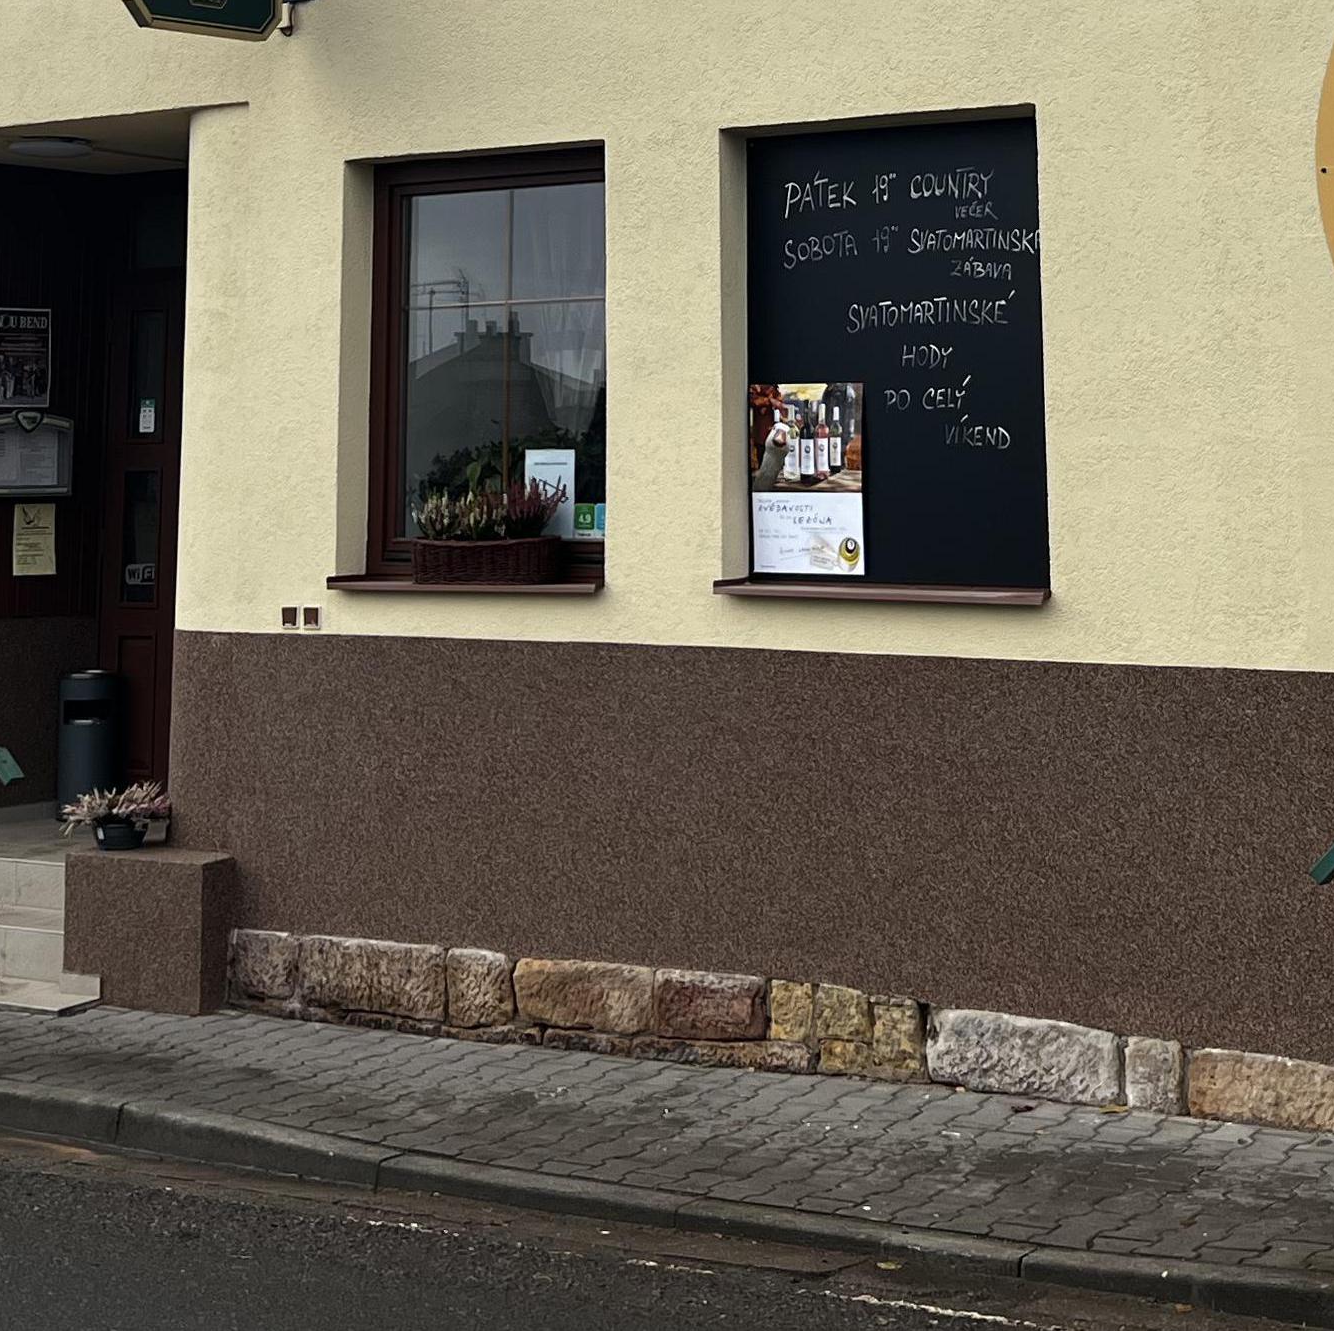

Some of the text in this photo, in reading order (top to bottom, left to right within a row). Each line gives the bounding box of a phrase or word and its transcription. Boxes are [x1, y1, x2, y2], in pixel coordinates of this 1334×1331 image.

[784, 171, 857, 219] PÁTEK
[910, 166, 995, 199] COUNTRY
[955, 201, 999, 220] VEČER
[784, 229, 858, 269] SOBOTA
[950, 256, 1012, 280] ZÁBAVA
[846, 289, 1016, 333] SVATOMARTINSKÉ
[902, 344, 953, 369] HODY
[884, 375, 971, 410] PO CELÝ
[945, 414, 1011, 449] VÍKEND
